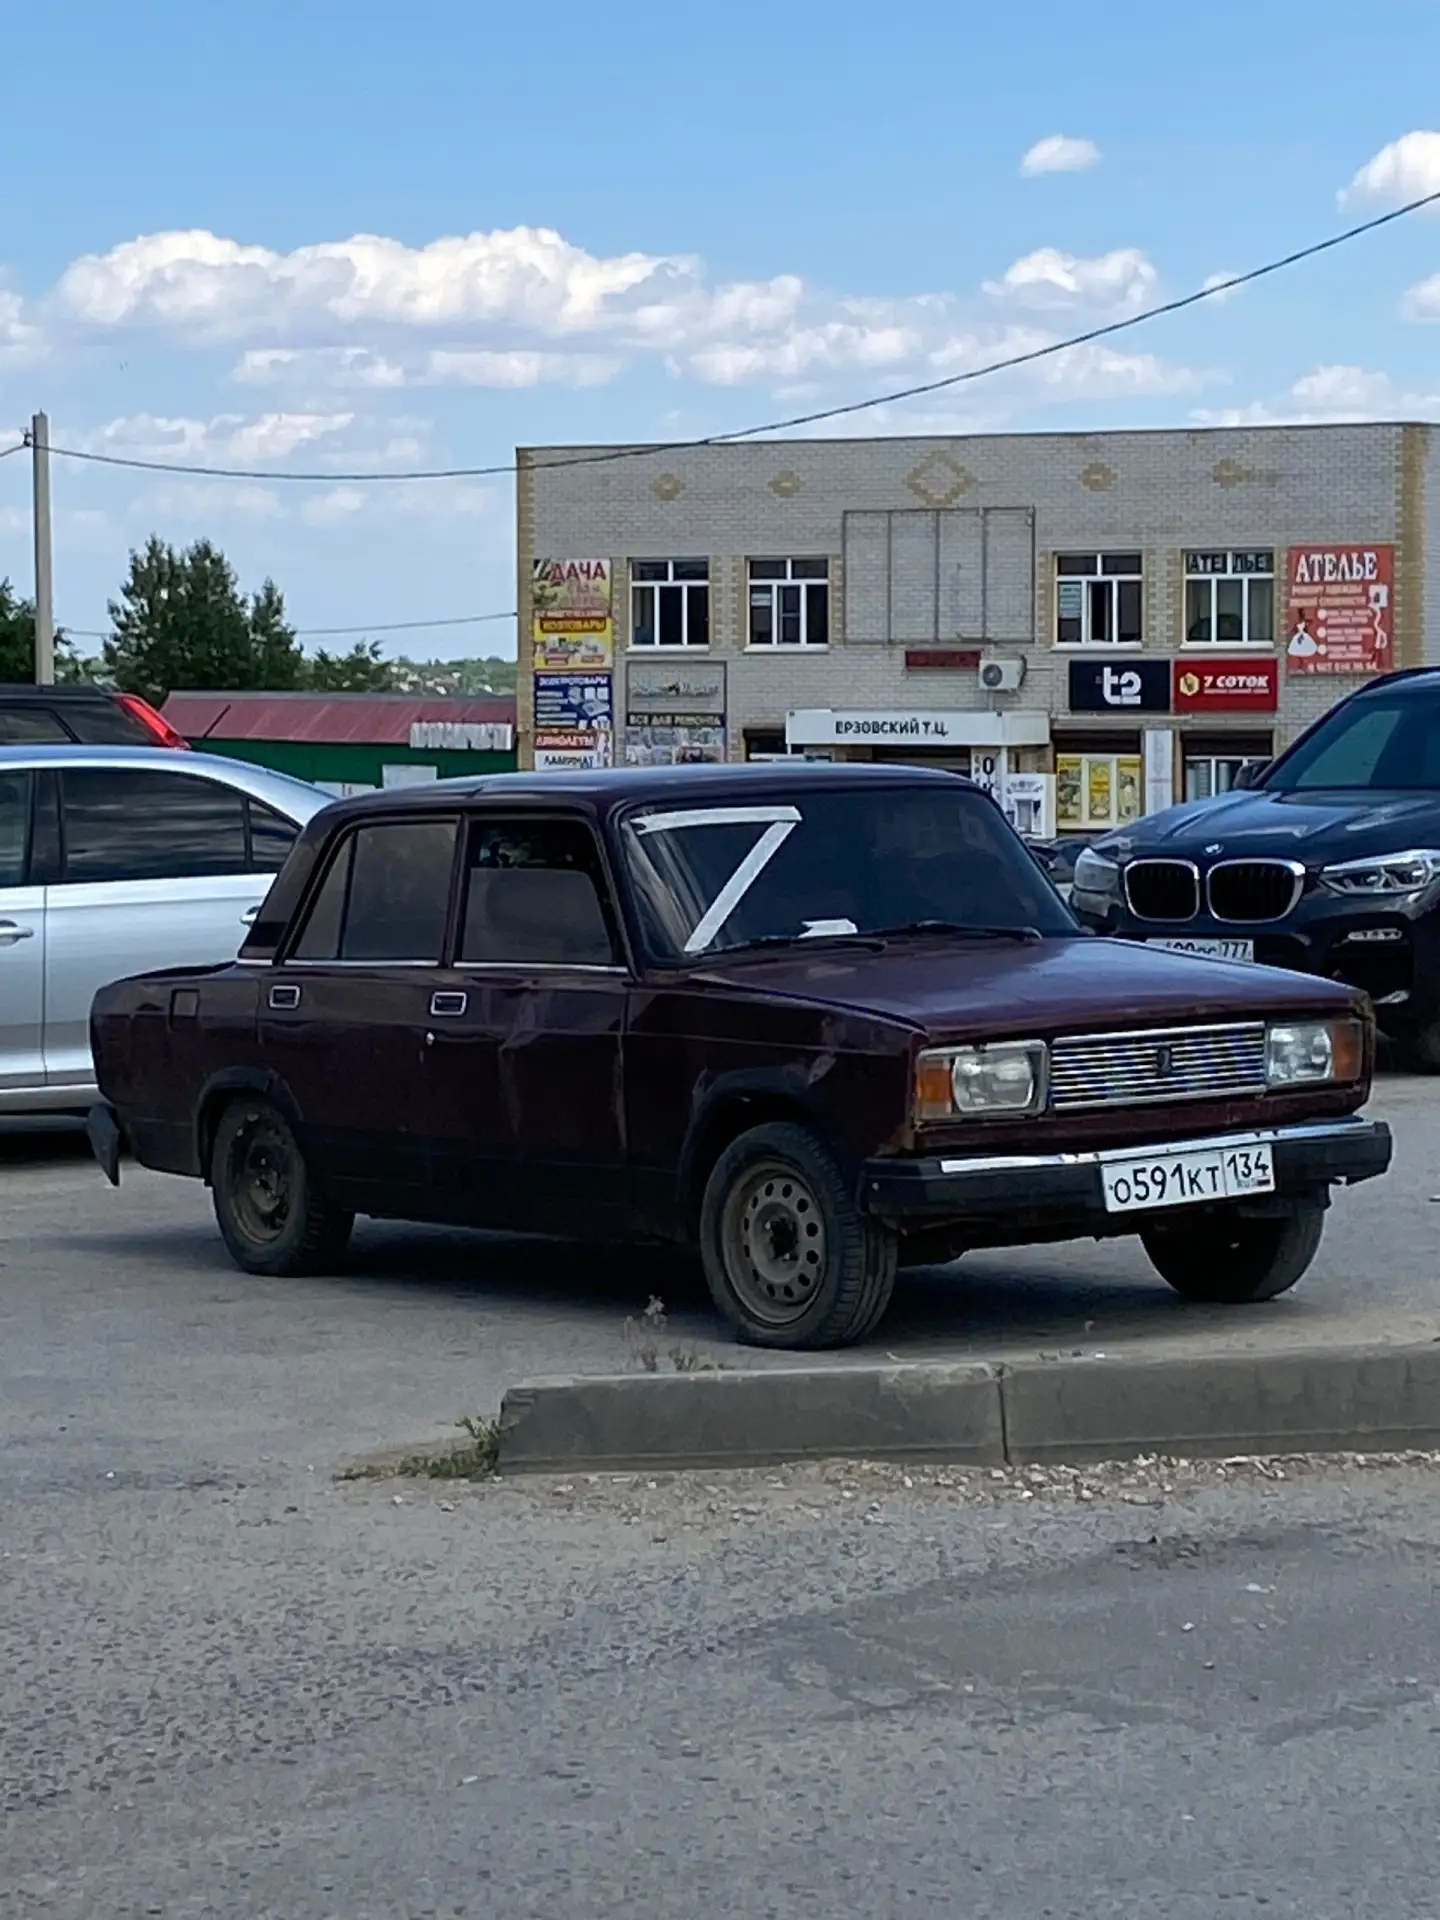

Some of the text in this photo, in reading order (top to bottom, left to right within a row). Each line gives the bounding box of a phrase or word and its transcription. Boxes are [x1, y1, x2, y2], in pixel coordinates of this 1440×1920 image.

[550, 561, 607, 585] ДАЧА
[1295, 551, 1378, 582] АТЕЛЬЕ
[1203, 675, 1270, 688] 7 СОТОК
[835, 717, 920, 734] ЕРЗОВСКИЙ
[1113, 1151, 1269, 1204] О591КТ 134
